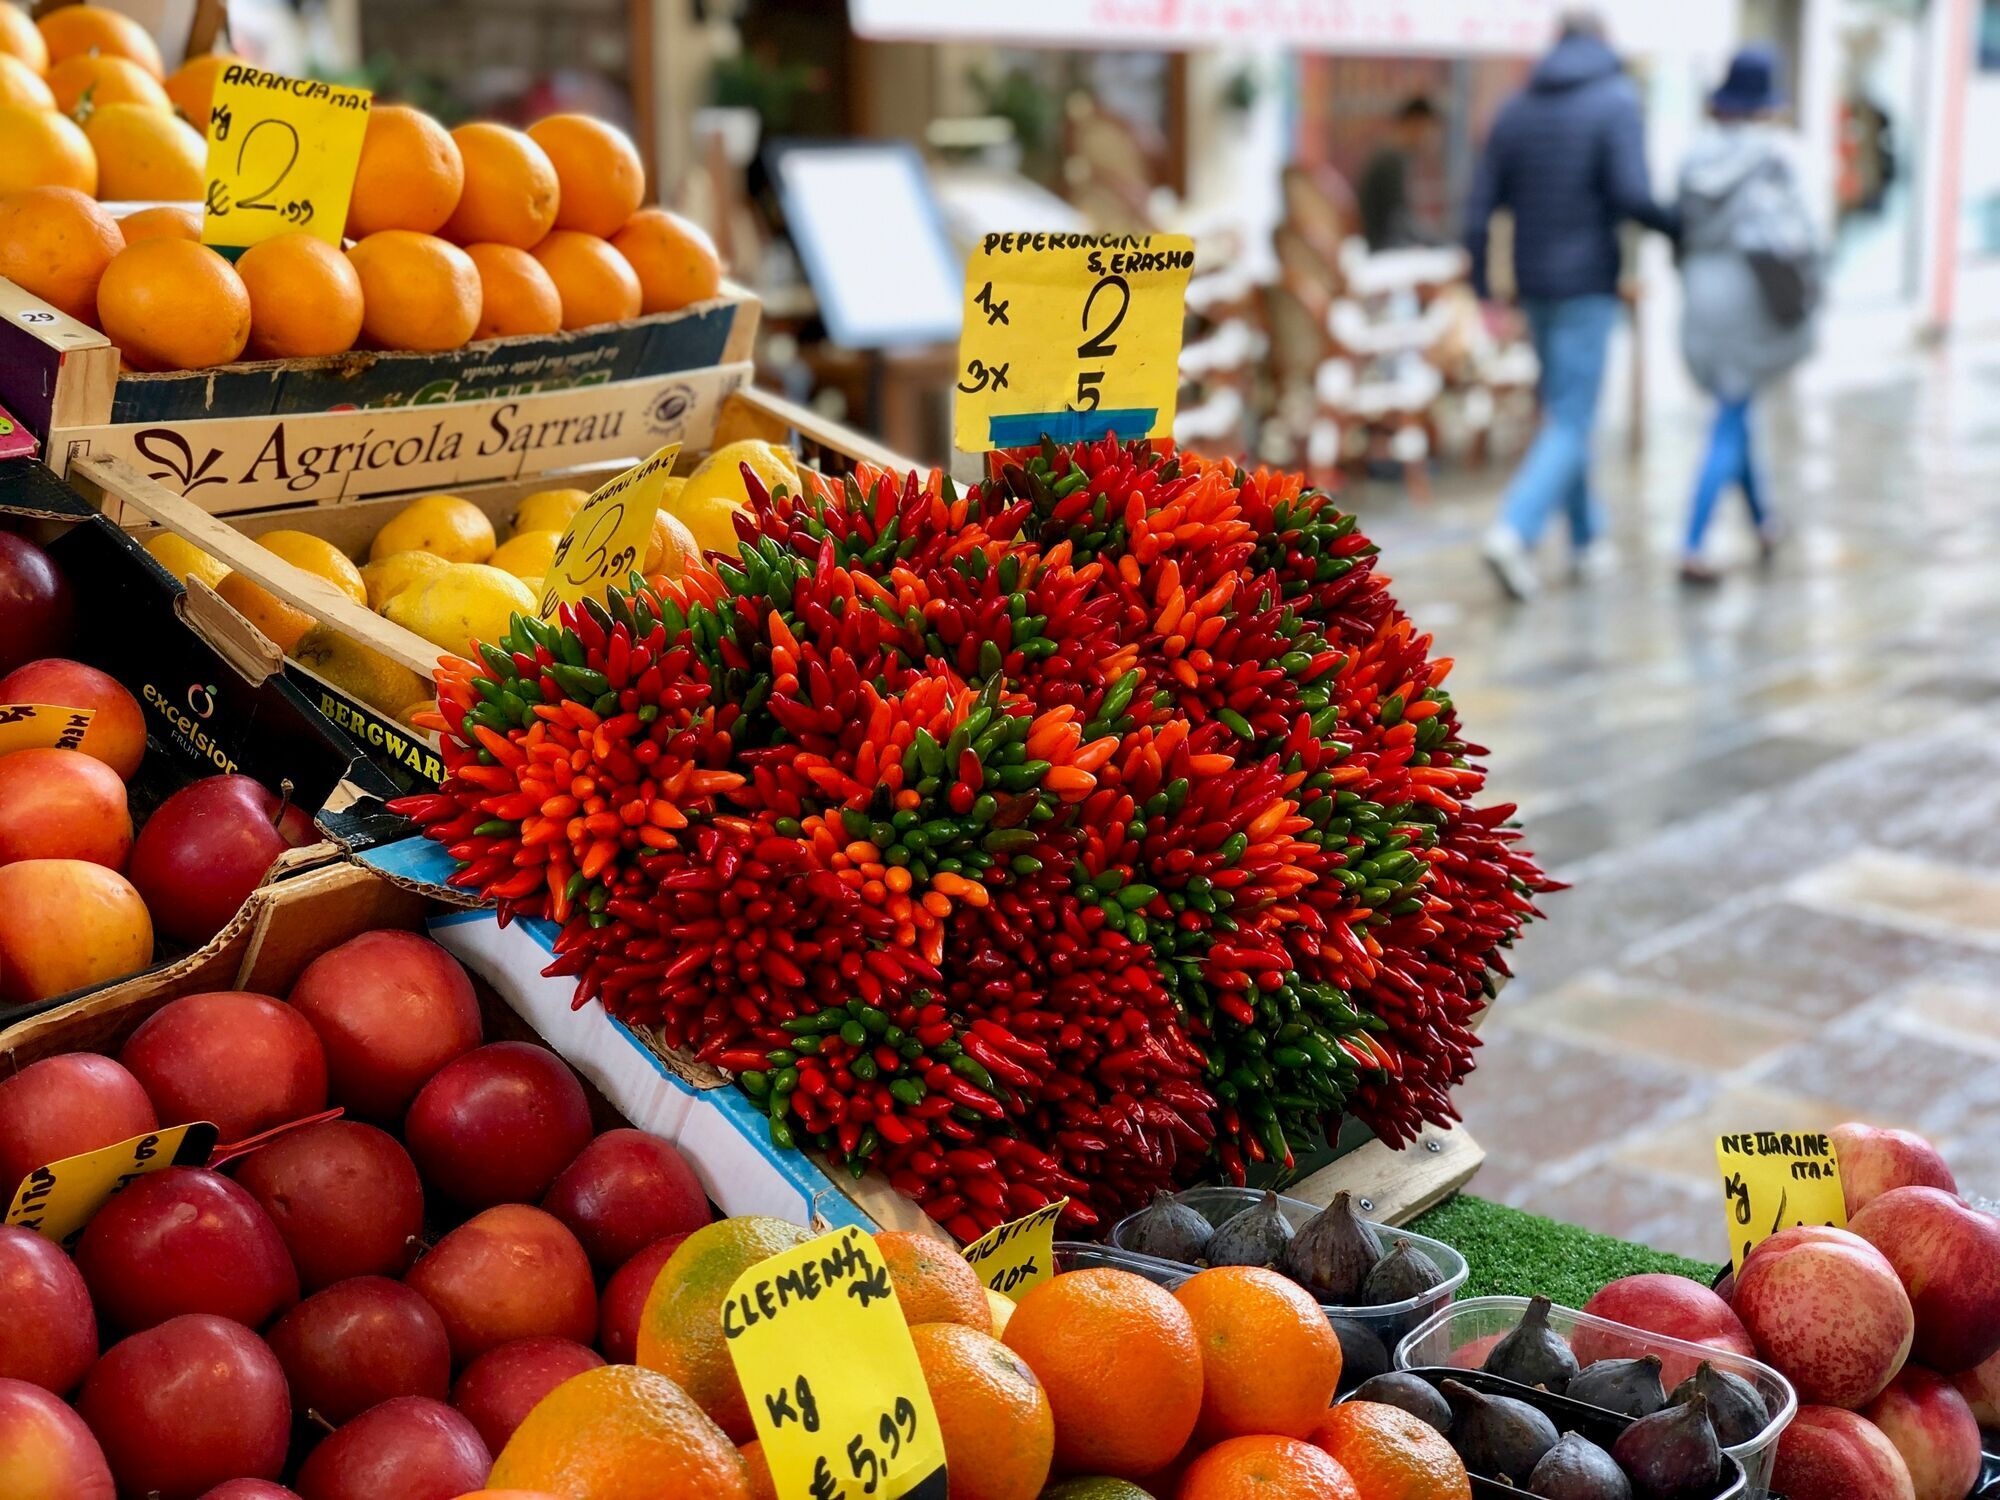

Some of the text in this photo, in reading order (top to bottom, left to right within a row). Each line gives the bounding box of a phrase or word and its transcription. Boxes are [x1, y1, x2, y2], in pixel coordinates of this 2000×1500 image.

[22, 312, 55, 323] 29
[1077, 275, 1130, 359] 2
[1064, 371, 1105, 413] 5
[238, 421, 463, 491] Agrícola
[476, 403, 626, 456] Sarrau
[142, 683, 239, 776] excelsior
[171, 729, 201, 760] FRUIT
[1721, 1131, 1830, 1157] NETTARINE
[846, 1396, 918, 1495] 5,99
